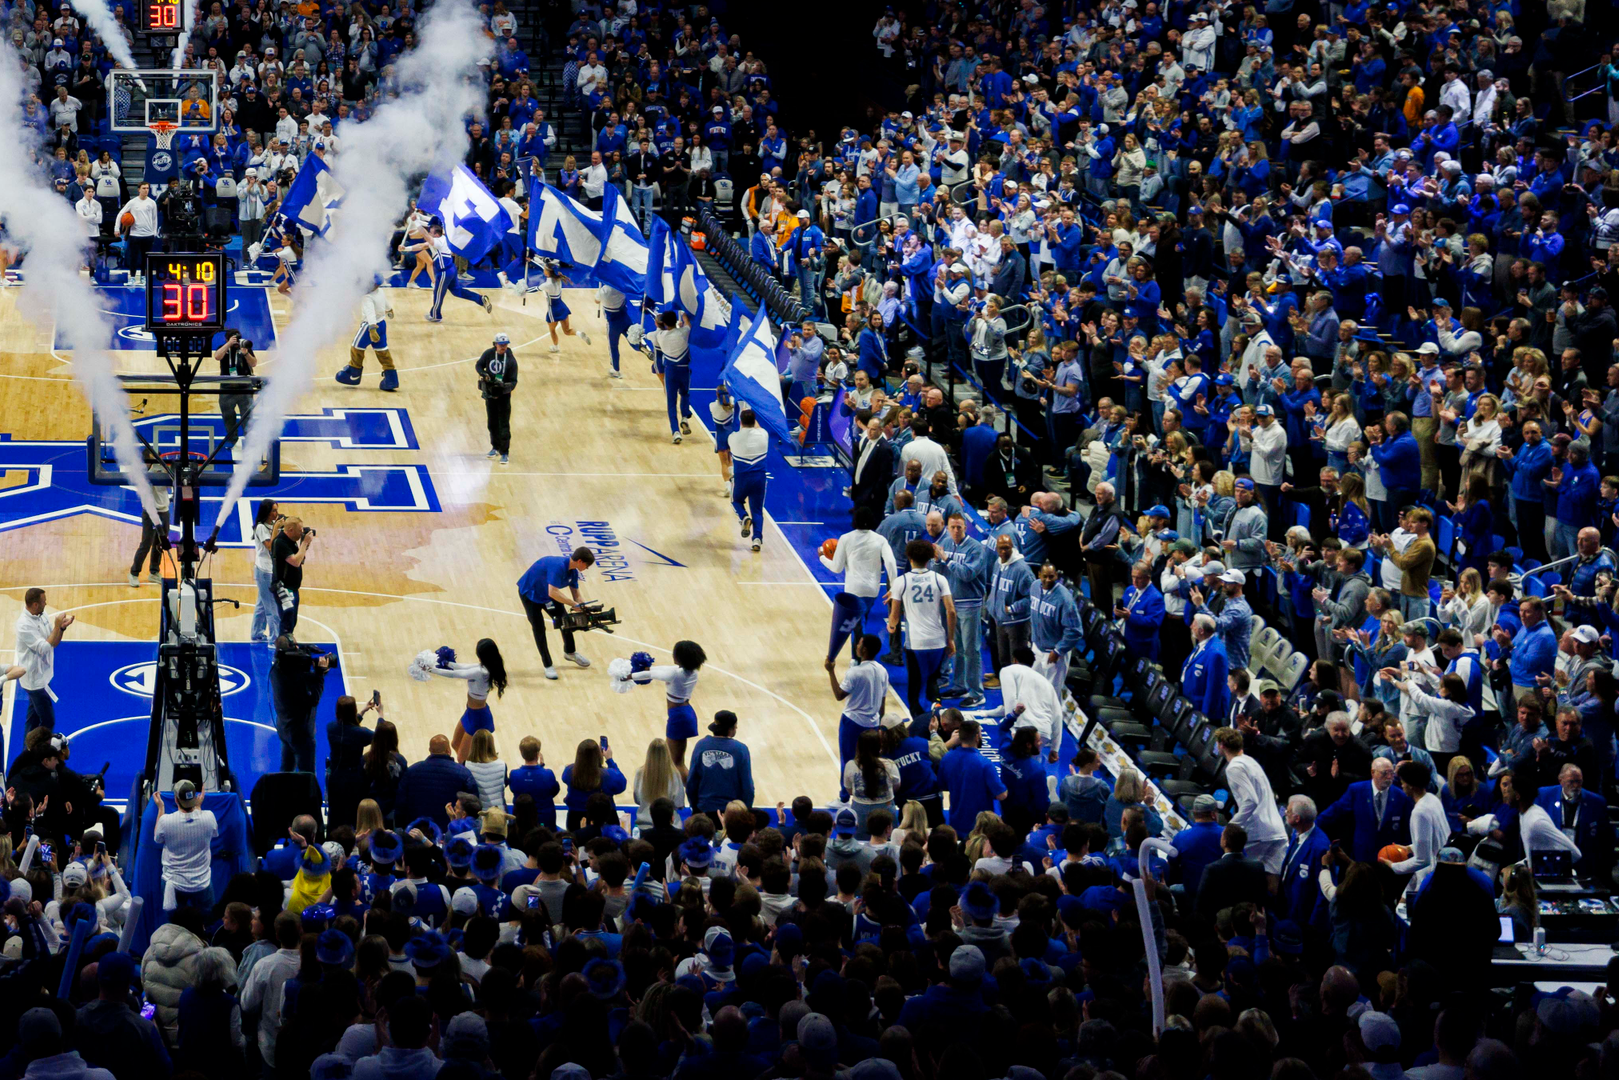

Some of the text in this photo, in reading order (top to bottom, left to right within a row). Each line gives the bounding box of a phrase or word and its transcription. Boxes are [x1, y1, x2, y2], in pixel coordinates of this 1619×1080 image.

[149, 5, 176, 27] 30
[168, 261, 214, 281] 4:10
[163, 284, 208, 319] 30
[575, 521, 636, 582] RUPP ARENA
[911, 584, 935, 603] 24
[894, 751, 922, 769] TUCKY
